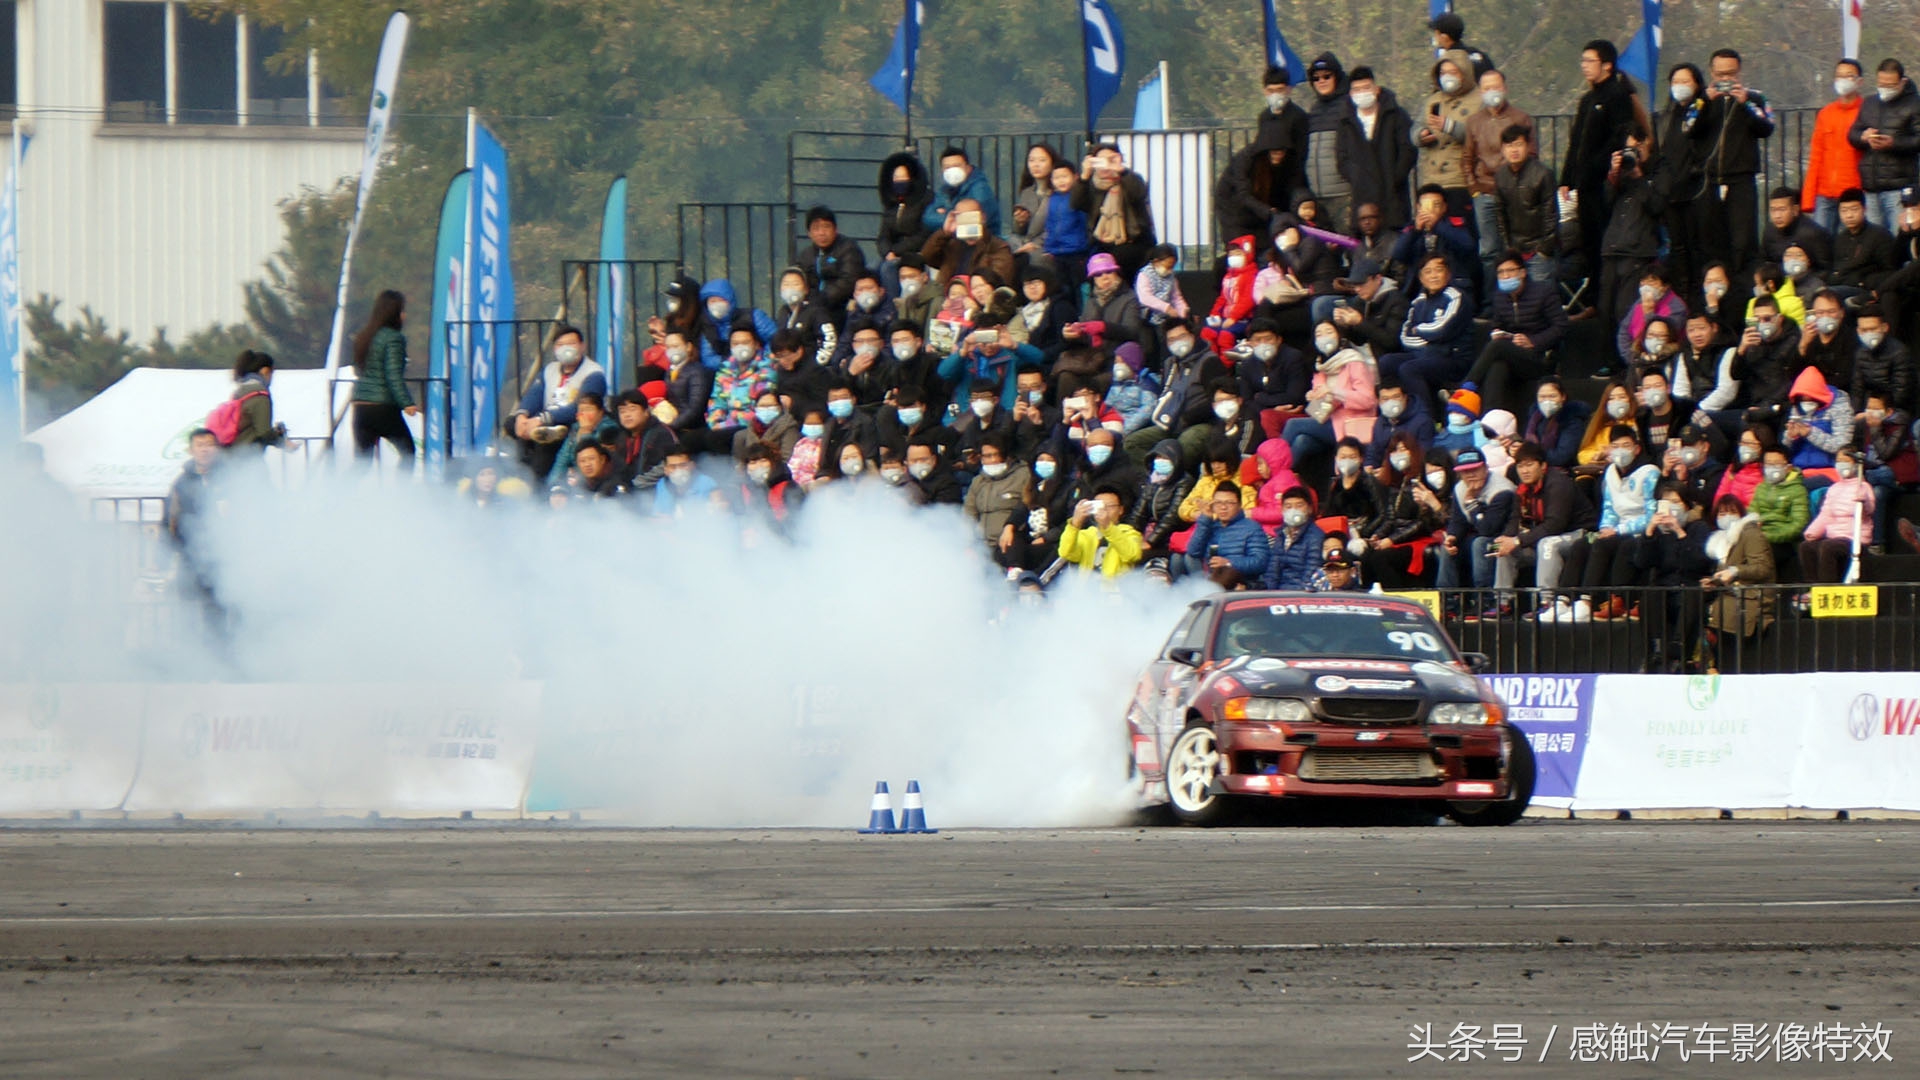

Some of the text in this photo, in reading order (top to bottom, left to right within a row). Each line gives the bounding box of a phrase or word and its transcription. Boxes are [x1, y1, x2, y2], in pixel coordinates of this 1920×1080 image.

[1269, 605, 1299, 615] D1
[1817, 592, 1872, 610] 请勿依靠
[1387, 631, 1441, 651] 90
[1526, 677, 1582, 707] PRIX
